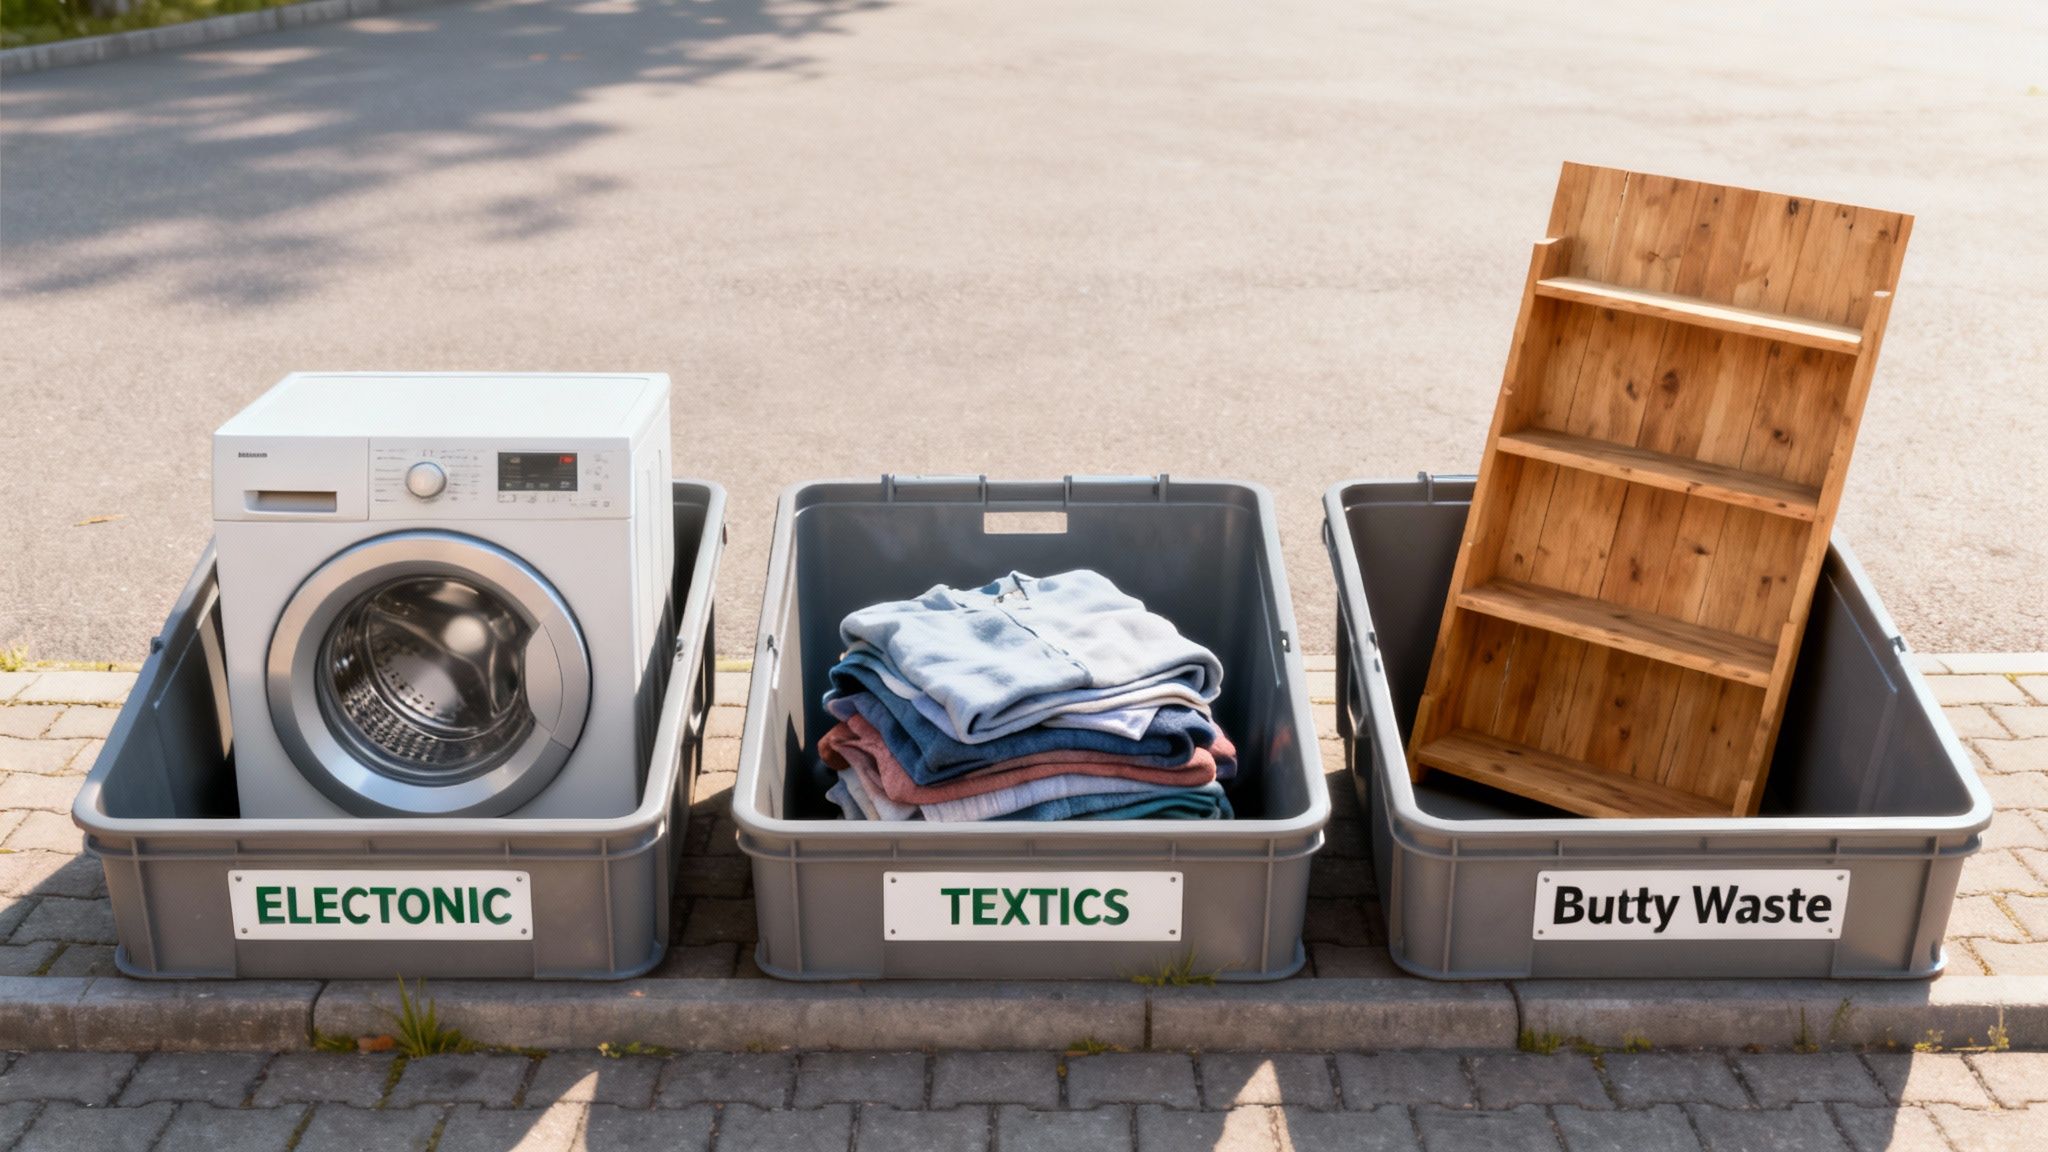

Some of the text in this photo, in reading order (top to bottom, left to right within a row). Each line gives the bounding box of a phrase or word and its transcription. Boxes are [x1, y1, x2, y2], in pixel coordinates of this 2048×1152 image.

[255, 886, 513, 925] ELECTONIC
[940, 887, 1130, 926] TEXTICS
[1552, 884, 1832, 934] Butty Waste
